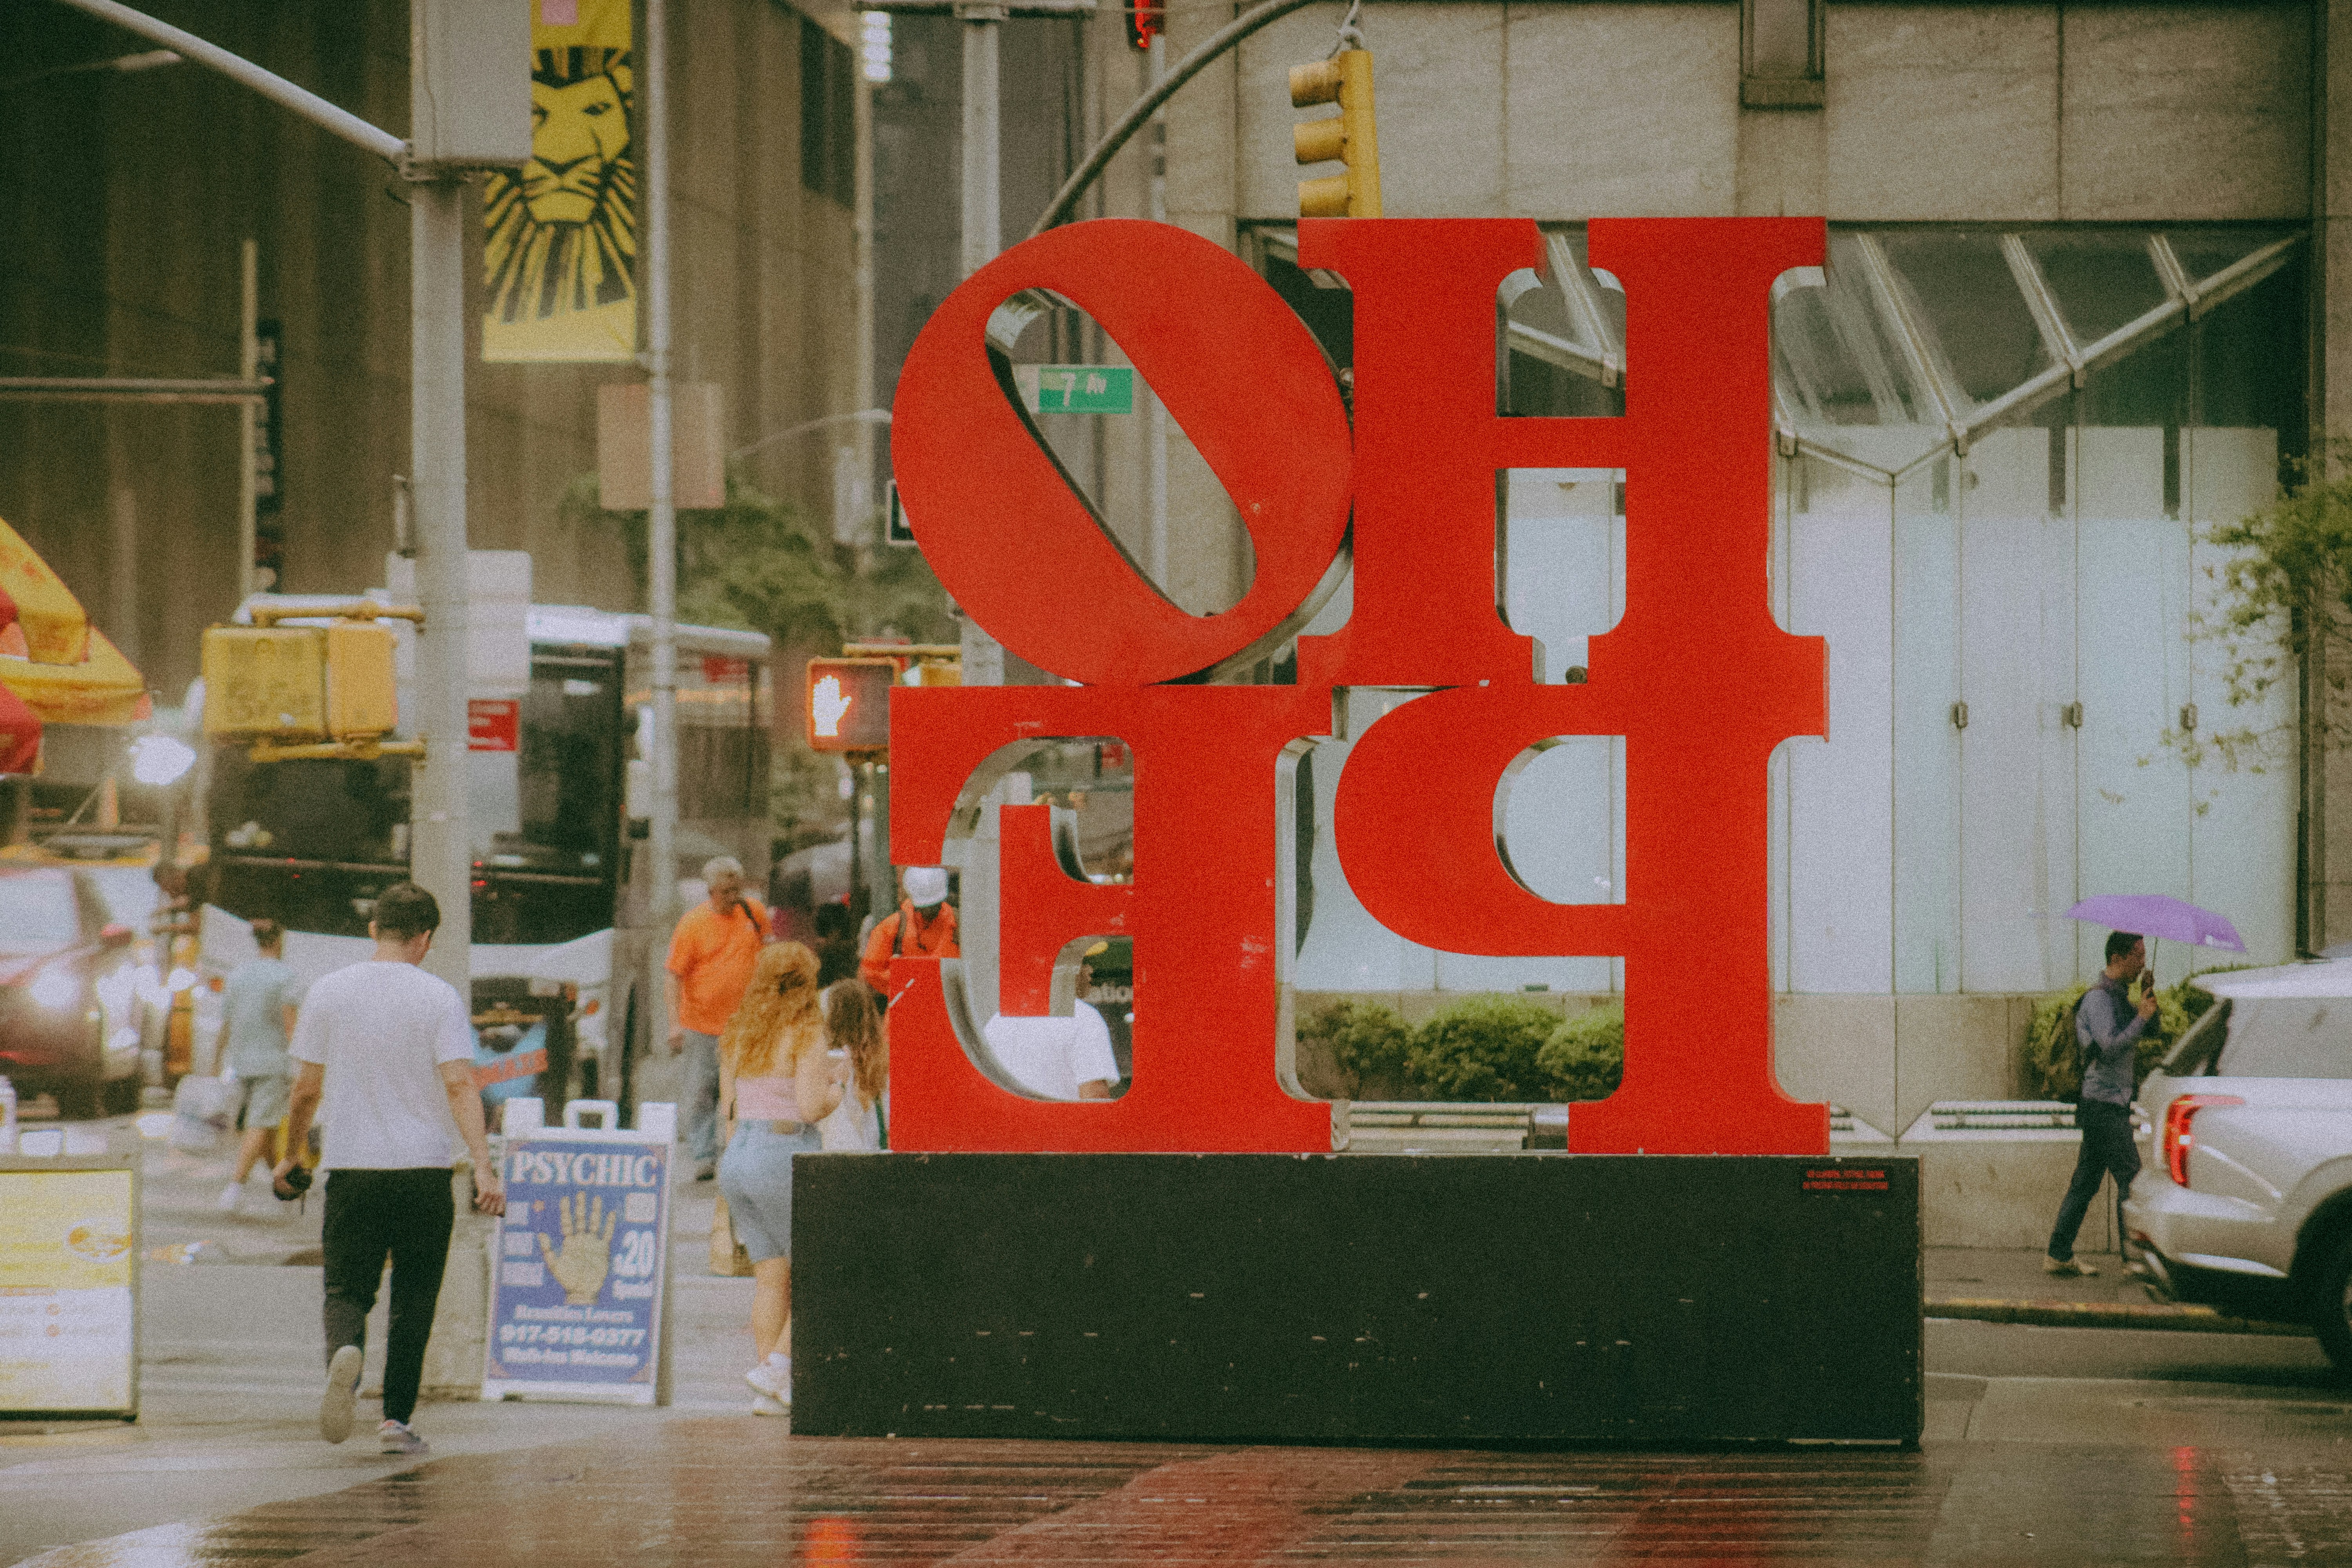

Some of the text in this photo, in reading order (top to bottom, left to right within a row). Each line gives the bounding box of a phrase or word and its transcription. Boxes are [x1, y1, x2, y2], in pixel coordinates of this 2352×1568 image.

[1061, 372, 1107, 407] 7 Av
[511, 1151, 658, 1187] PSYCHIC
